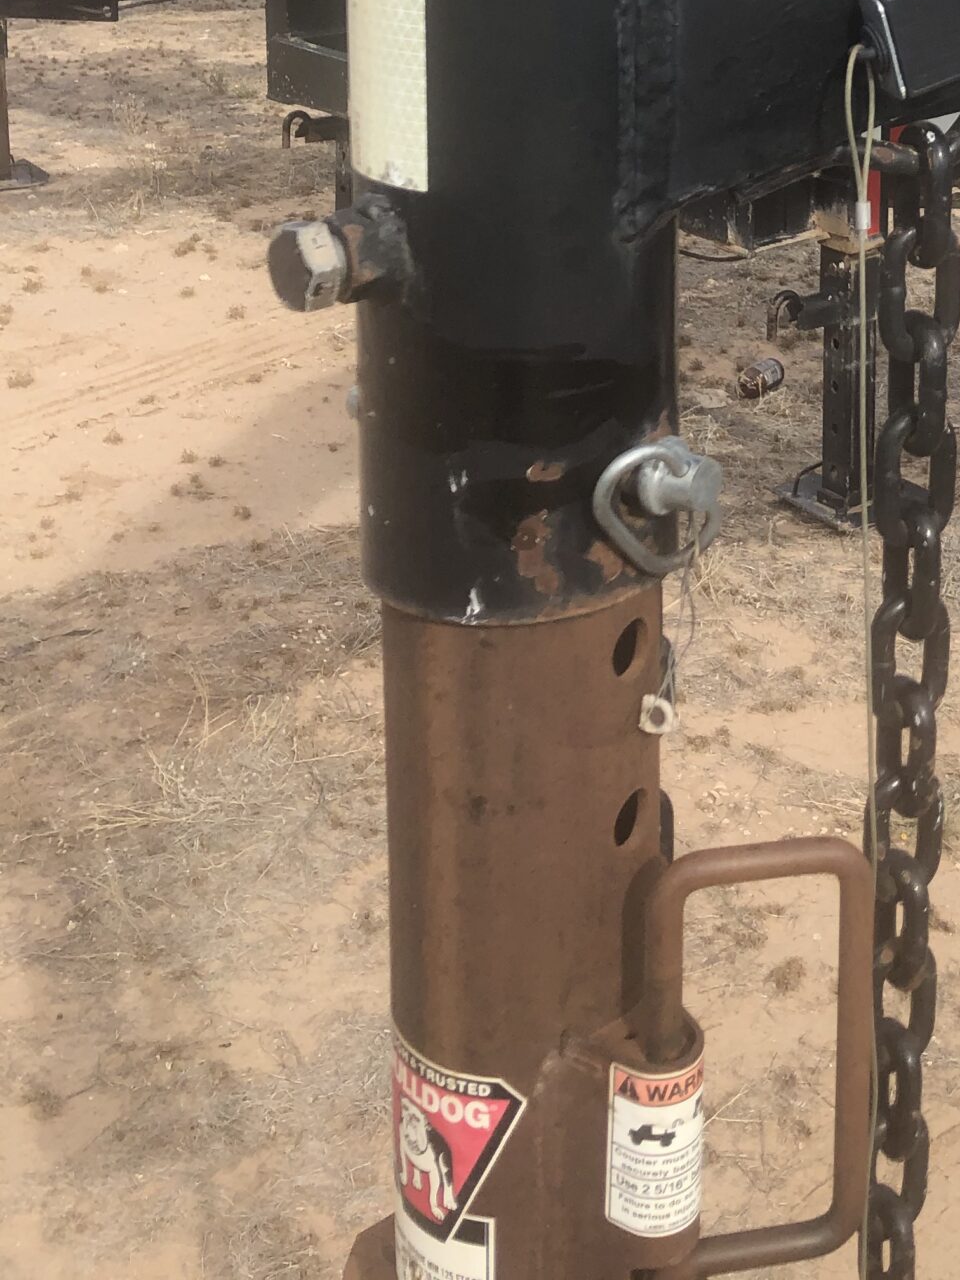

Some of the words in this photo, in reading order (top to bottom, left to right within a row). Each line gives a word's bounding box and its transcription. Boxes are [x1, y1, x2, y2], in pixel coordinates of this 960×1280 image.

[394, 1058, 491, 1130] ULLDOG
[419, 1061, 491, 1097] TRUSTED
[645, 1069, 704, 1102] WARN
[616, 1173, 638, 1191] Use
[642, 1184, 650, 1194] 2
